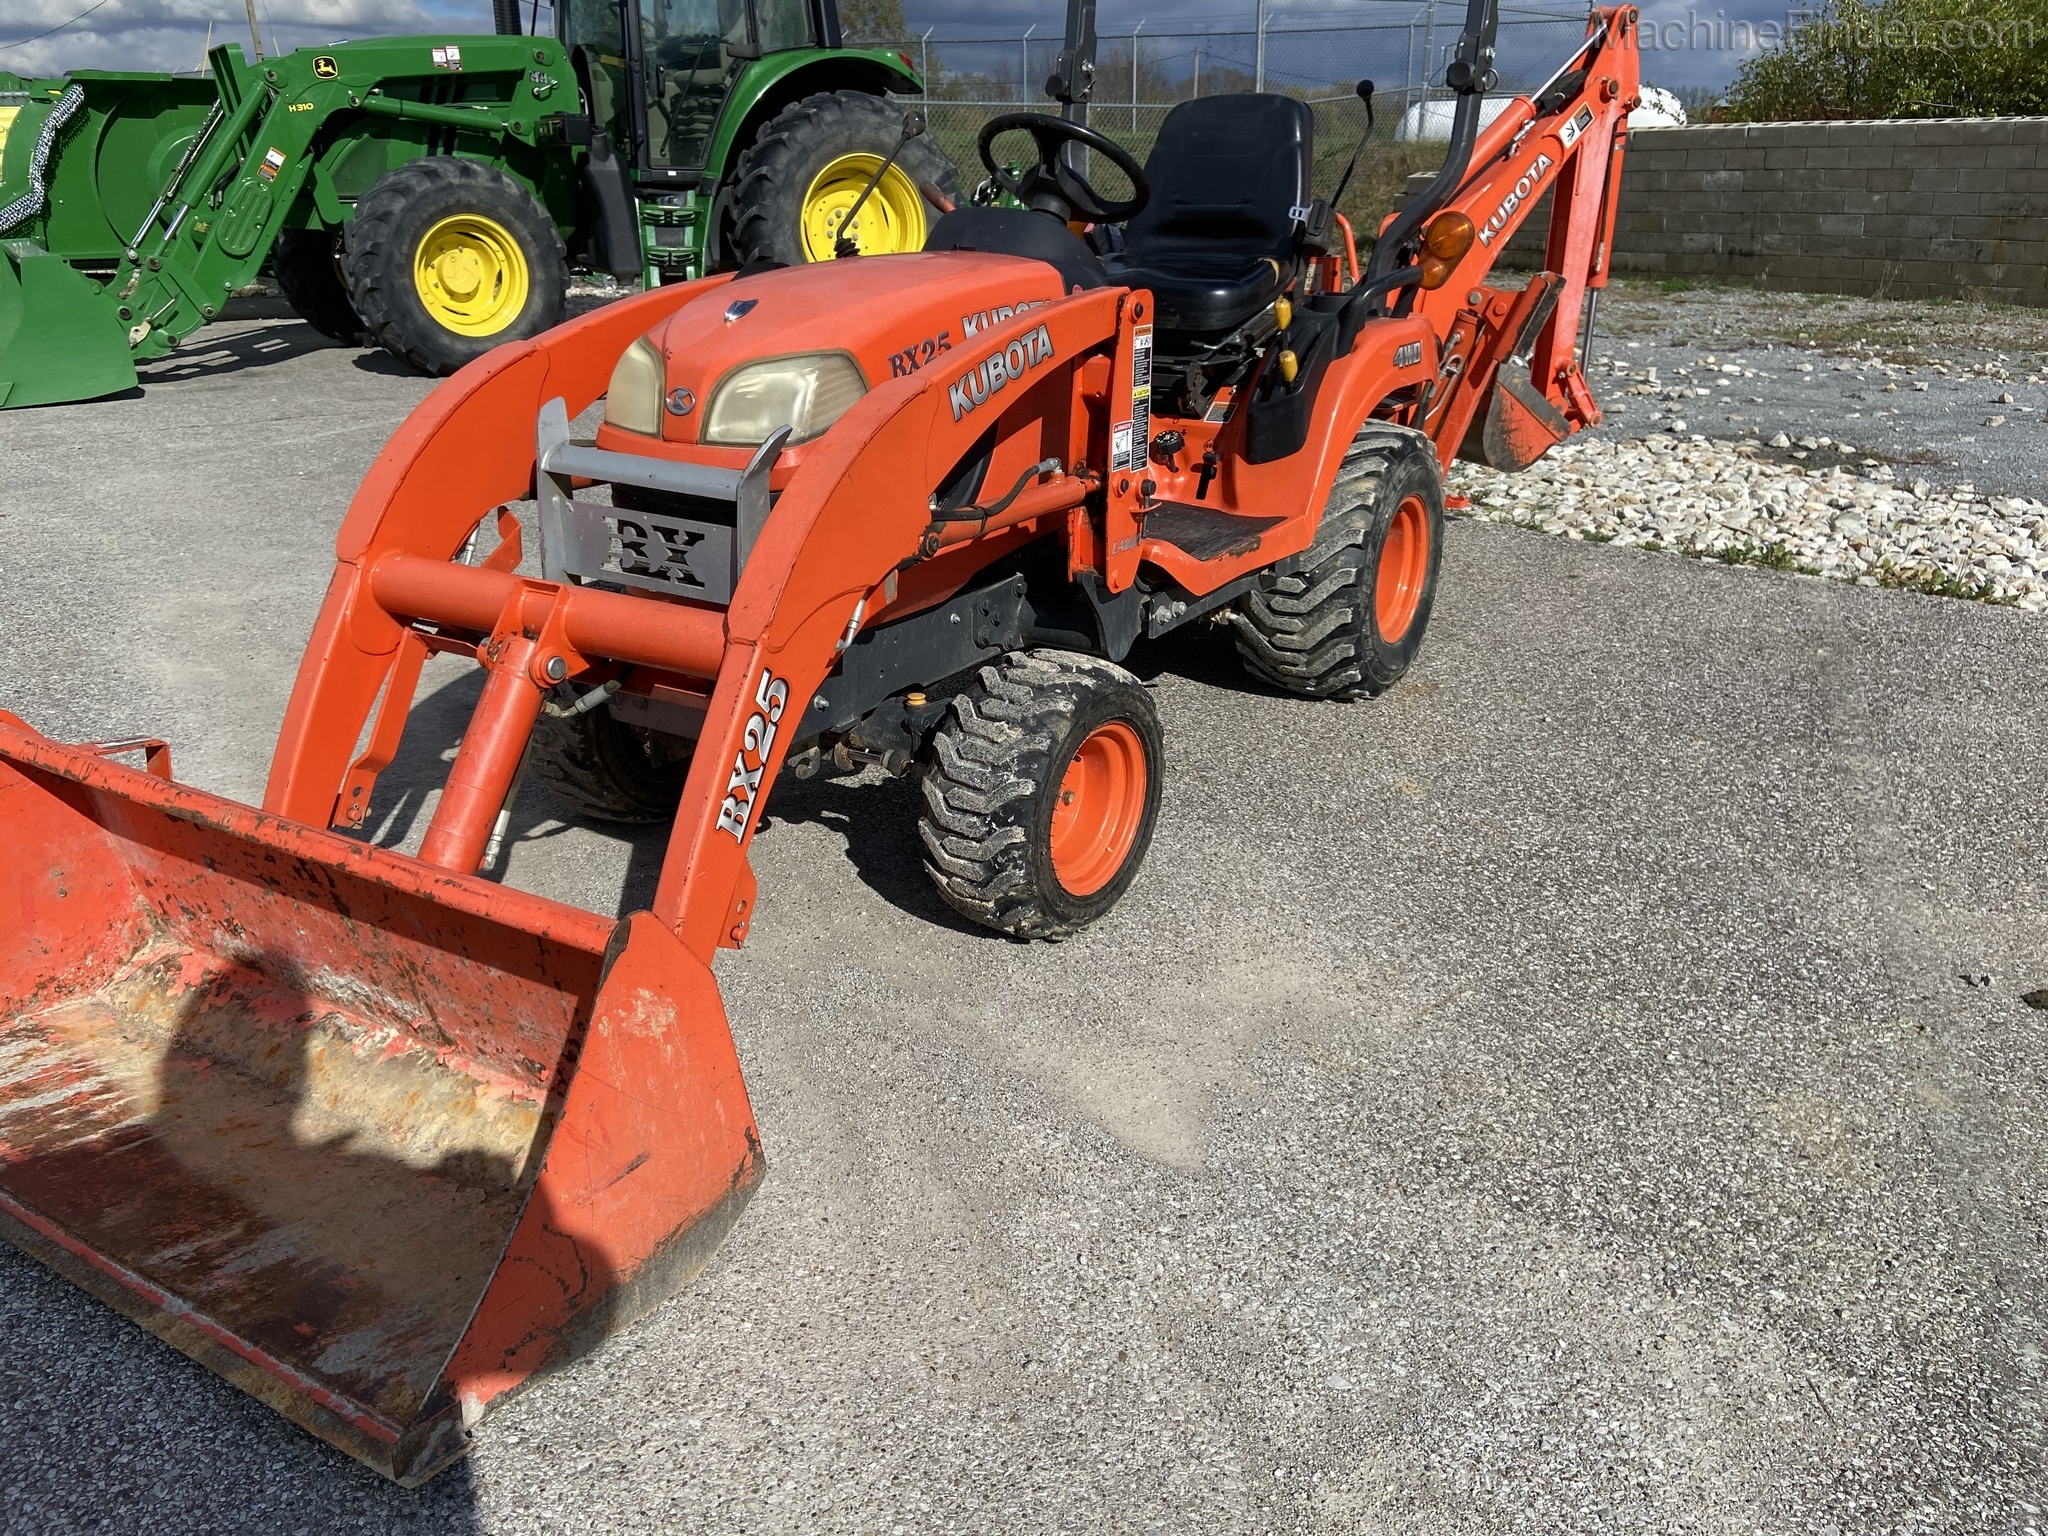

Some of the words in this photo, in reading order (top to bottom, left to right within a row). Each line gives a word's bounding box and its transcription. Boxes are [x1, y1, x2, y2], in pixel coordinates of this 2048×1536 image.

[288, 102, 314, 112] H310
[1477, 153, 1554, 248] KUBOTA
[948, 324, 1054, 422] KUBOTA
[1393, 341, 1421, 369] 4WD
[600, 516, 705, 590] BX
[716, 667, 789, 845] BX25
